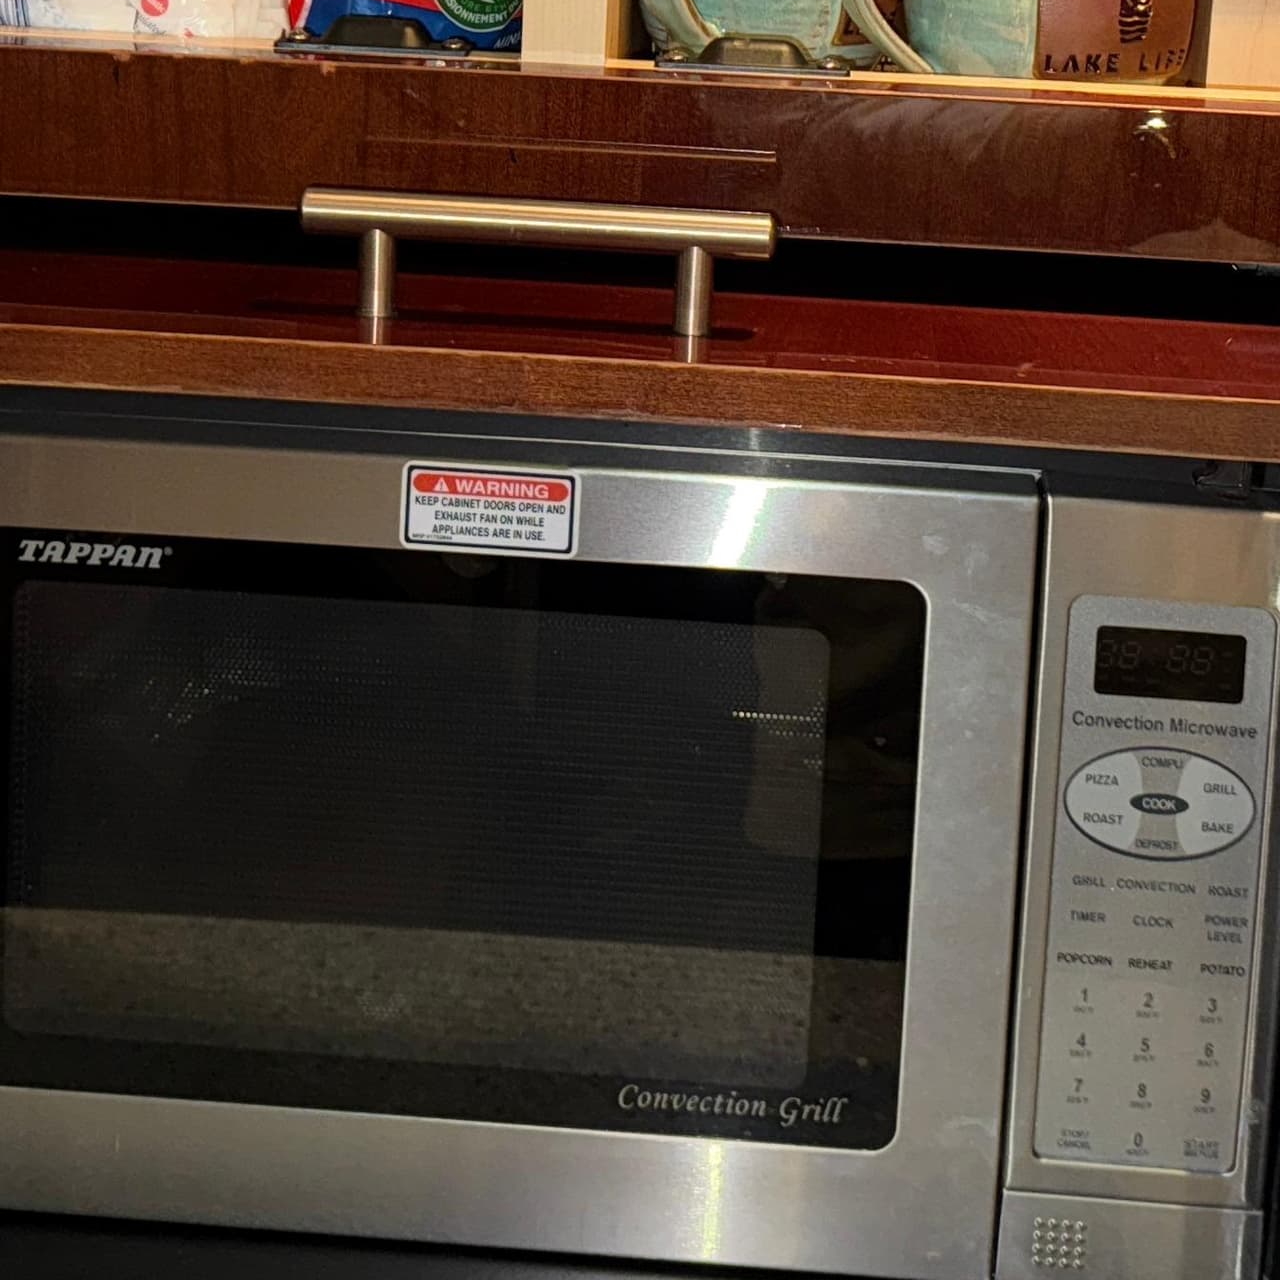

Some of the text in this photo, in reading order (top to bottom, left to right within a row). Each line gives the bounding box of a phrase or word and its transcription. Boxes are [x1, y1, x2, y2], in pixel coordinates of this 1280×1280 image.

[1043, 53, 1120, 74] LAKE
[455, 478, 549, 499] WARNING
[415, 496, 566, 515] KEEP CABINET DOORS OPEN AND
[434, 510, 545, 527] EXHAUST FAN ON WHILE
[431, 524, 489, 538] APPLIANCES
[491, 527, 510, 539] ARE
[513, 529, 522, 540] IN
[524, 530, 546, 542] USE.
[1071, 710, 1258, 739] Convection Microwave
[1141, 756, 1184, 769] COMPU
[1085, 773, 1119, 786] PIZZA
[1203, 783, 1237, 795] GRILL
[1142, 798, 1176, 810] COOK
[1083, 812, 1123, 825] ROAST
[1201, 821, 1233, 834] BAKE
[1135, 838, 1178, 851] DEFROST
[1072, 875, 1106, 888] GRILL
[1116, 878, 1196, 894] CONVECTION
[1208, 885, 1249, 898] ROAST
[1070, 910, 1106, 922] TIMER
[1132, 915, 1174, 928] CLOCK
[1204, 914, 1248, 928] POWER
[1207, 931, 1242, 944] LEVEL
[1057, 951, 1113, 966] POPCORN
[1128, 957, 1173, 970] REHEAT
[1200, 963, 1246, 977] POTATO
[1080, 987, 1088, 1002] 1
[1143, 992, 1154, 1008] 2
[1207, 998, 1217, 1013] 3
[1076, 1033, 1086, 1047] 4
[1140, 1037, 1150, 1053] 5
[1204, 1042, 1214, 1058] 6
[1074, 1078, 1083, 1093] 7
[1137, 1083, 1147, 1098] 8
[1201, 1088, 1211, 1104] 9
[618, 1083, 849, 1128] Convection Grill
[1133, 1132, 1143, 1148] 0
